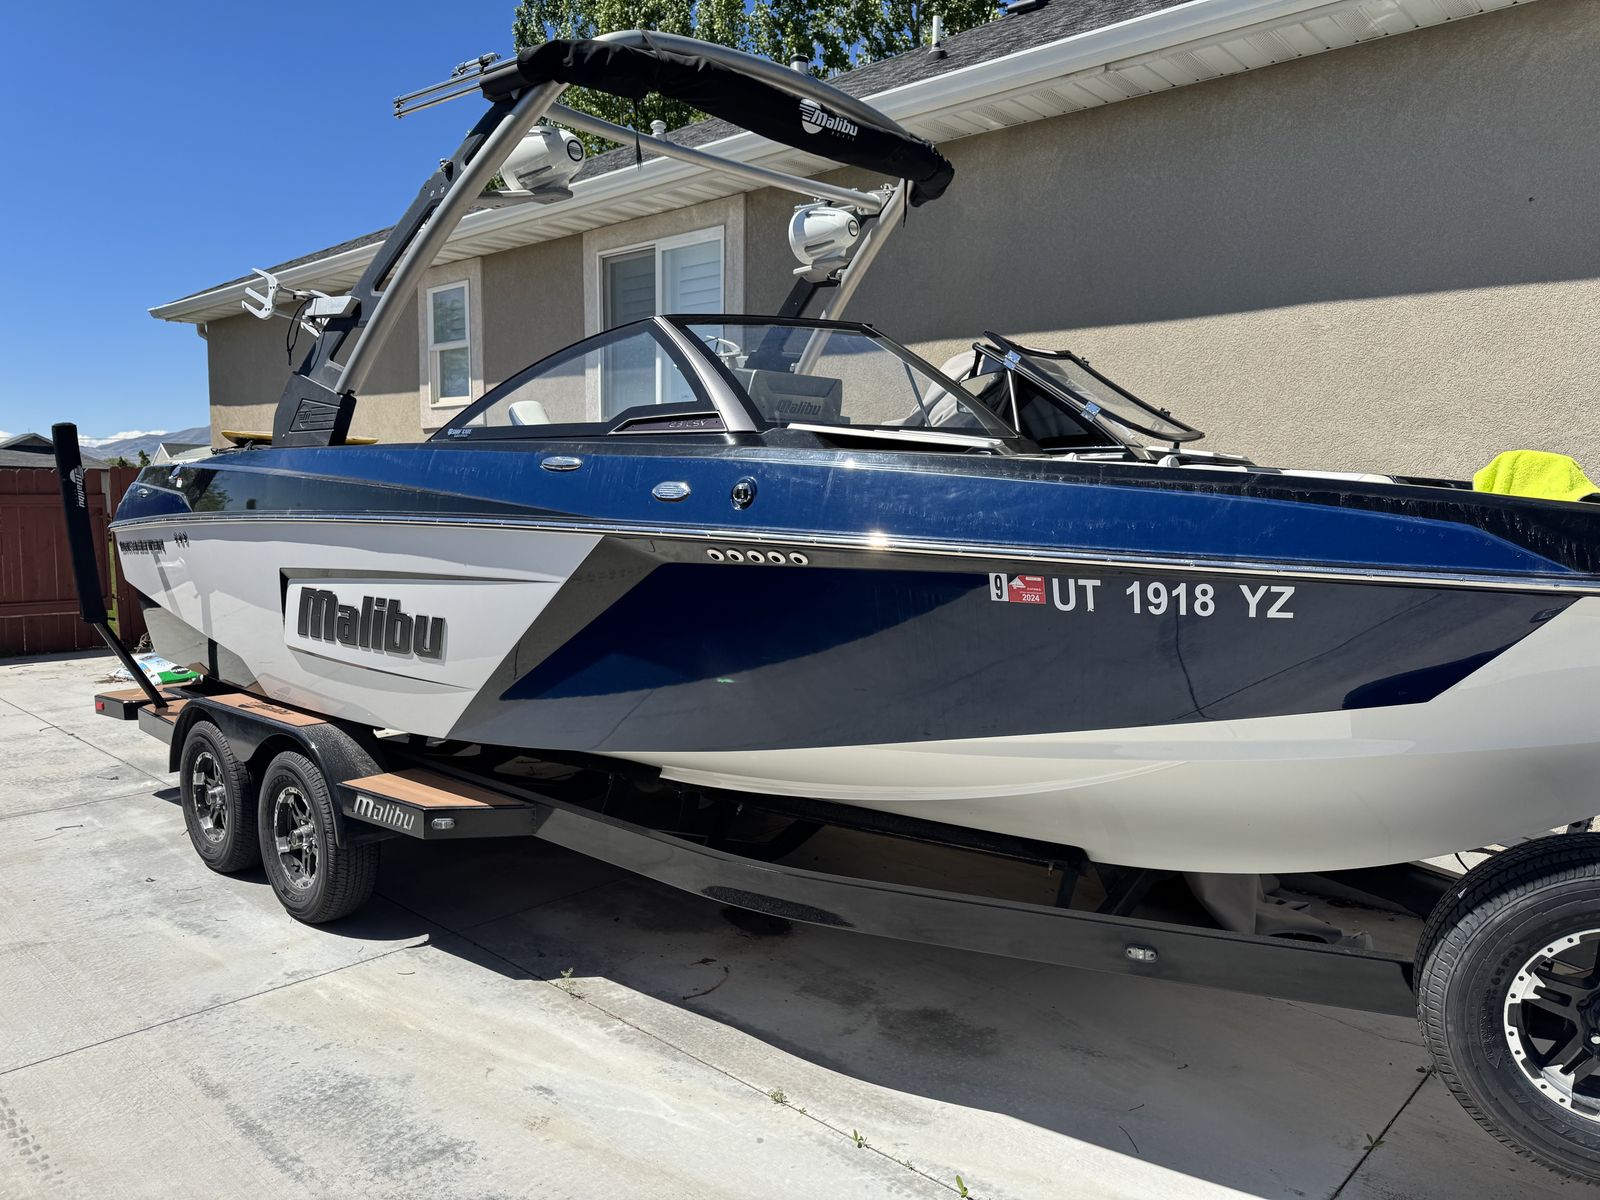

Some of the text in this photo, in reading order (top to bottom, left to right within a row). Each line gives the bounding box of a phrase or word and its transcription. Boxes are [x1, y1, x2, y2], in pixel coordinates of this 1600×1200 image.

[810, 109, 859, 136] Malibu
[775, 399, 822, 416] Malibu
[994, 574, 1004, 600] 9
[1022, 593, 1041, 602] 2024
[1052, 578, 1296, 619] UT 1918 YZ
[297, 586, 446, 663] Malibu
[353, 794, 415, 831] Malibu
